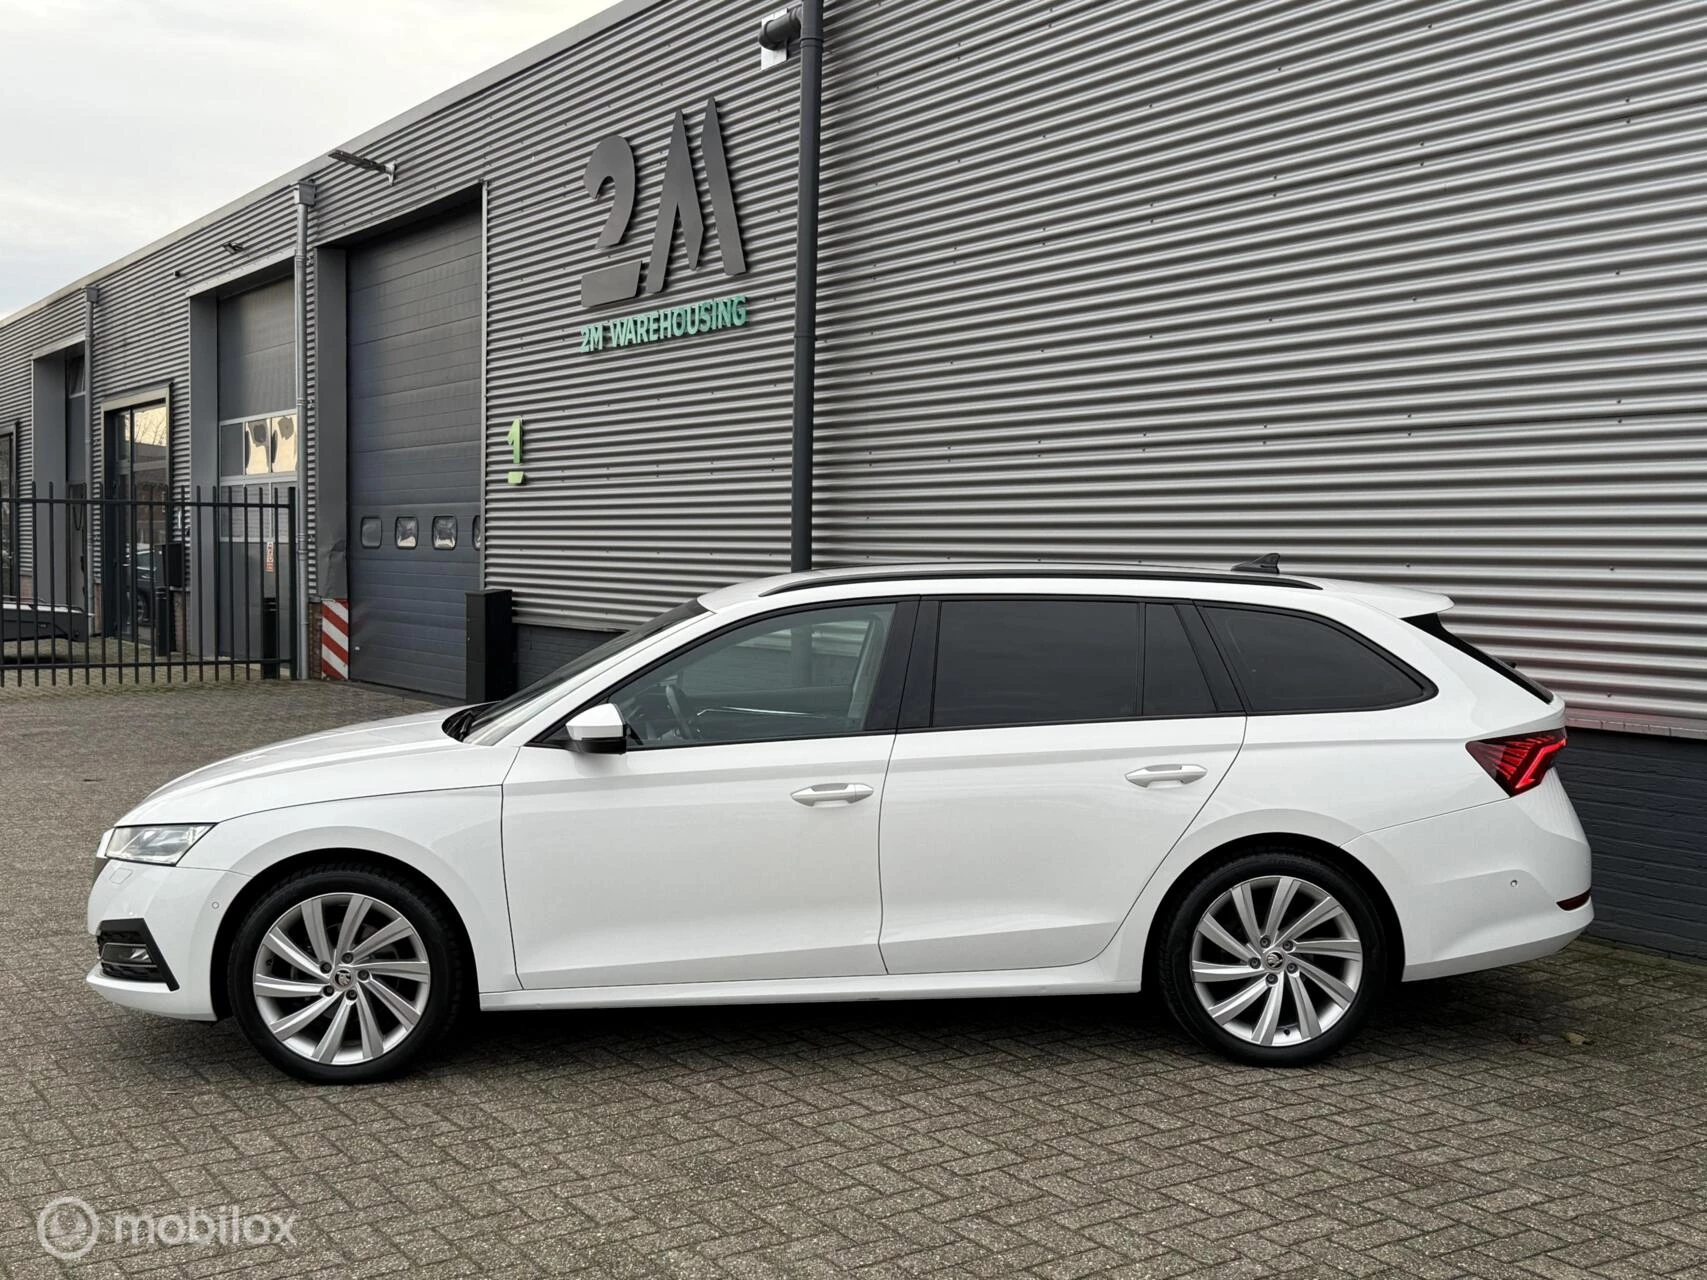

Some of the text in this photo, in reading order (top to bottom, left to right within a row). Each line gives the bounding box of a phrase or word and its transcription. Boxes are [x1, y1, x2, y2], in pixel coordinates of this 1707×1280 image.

[581, 97, 746, 308] 2M
[580, 296, 748, 353] 2M WAREHOUSING
